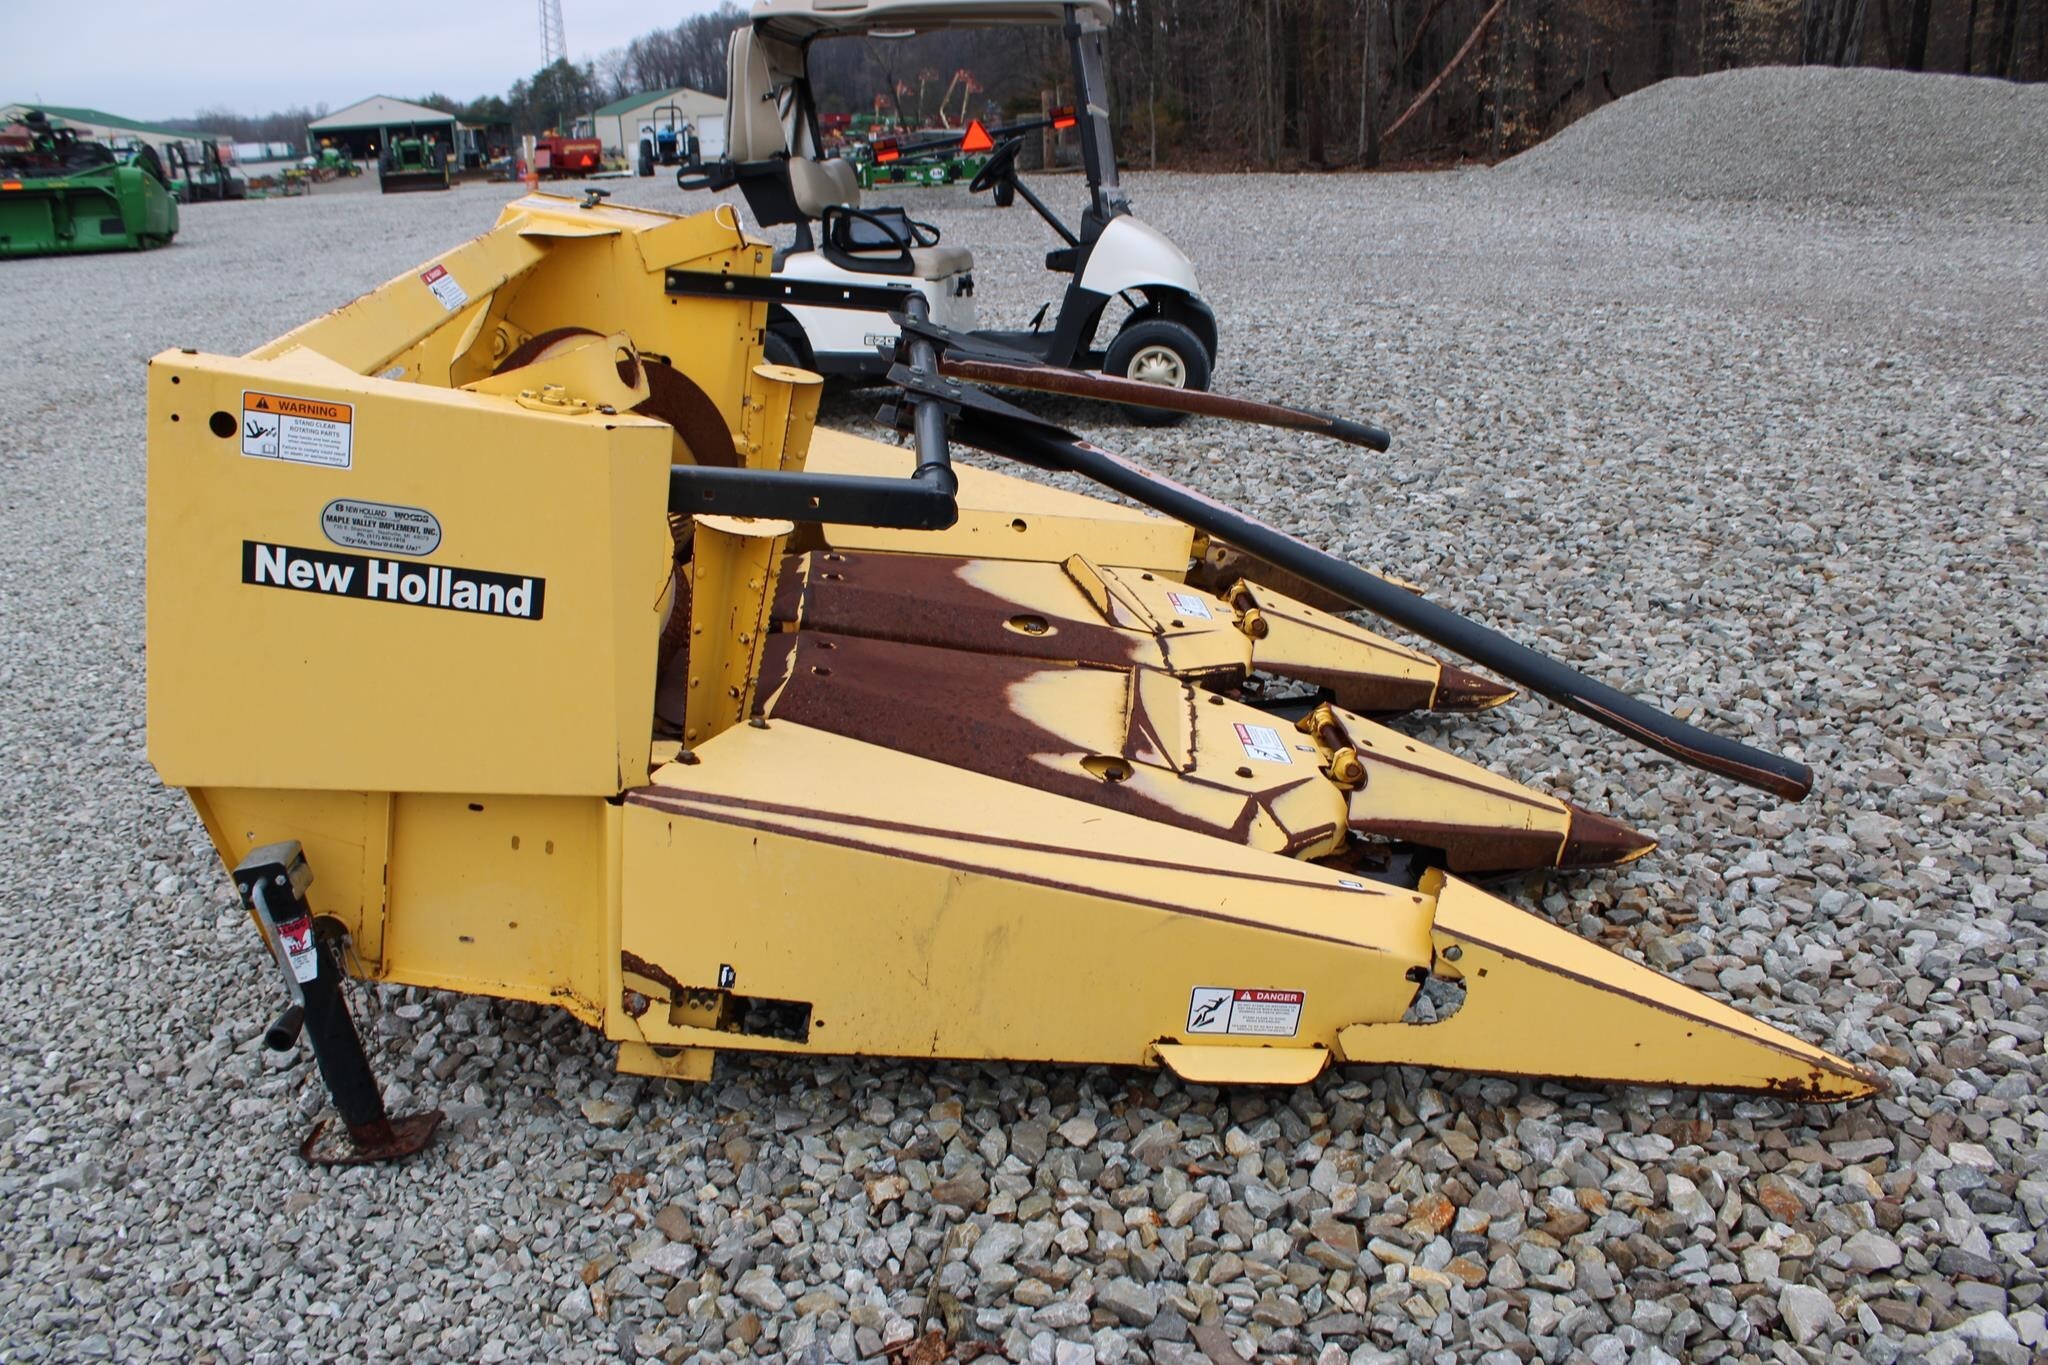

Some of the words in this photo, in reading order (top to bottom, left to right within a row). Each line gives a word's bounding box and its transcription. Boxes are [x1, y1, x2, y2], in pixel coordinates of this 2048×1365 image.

[278, 401, 338, 418] WARNING
[294, 419, 315, 427] STAND
[315, 421, 336, 430] CLEAR
[289, 426, 320, 436] ROTATING
[320, 429, 341, 438] PARTS
[359, 508, 387, 518] HOLLAND
[394, 511, 429, 523] WOODS
[326, 514, 351, 525] MAPLE
[352, 517, 377, 528] VALLEY
[378, 520, 422, 535] IMPLEMENT,
[423, 527, 438, 537] INC.
[254, 543, 355, 594] New
[366, 558, 533, 617] Holland
[1256, 991, 1298, 1002] DANGER
